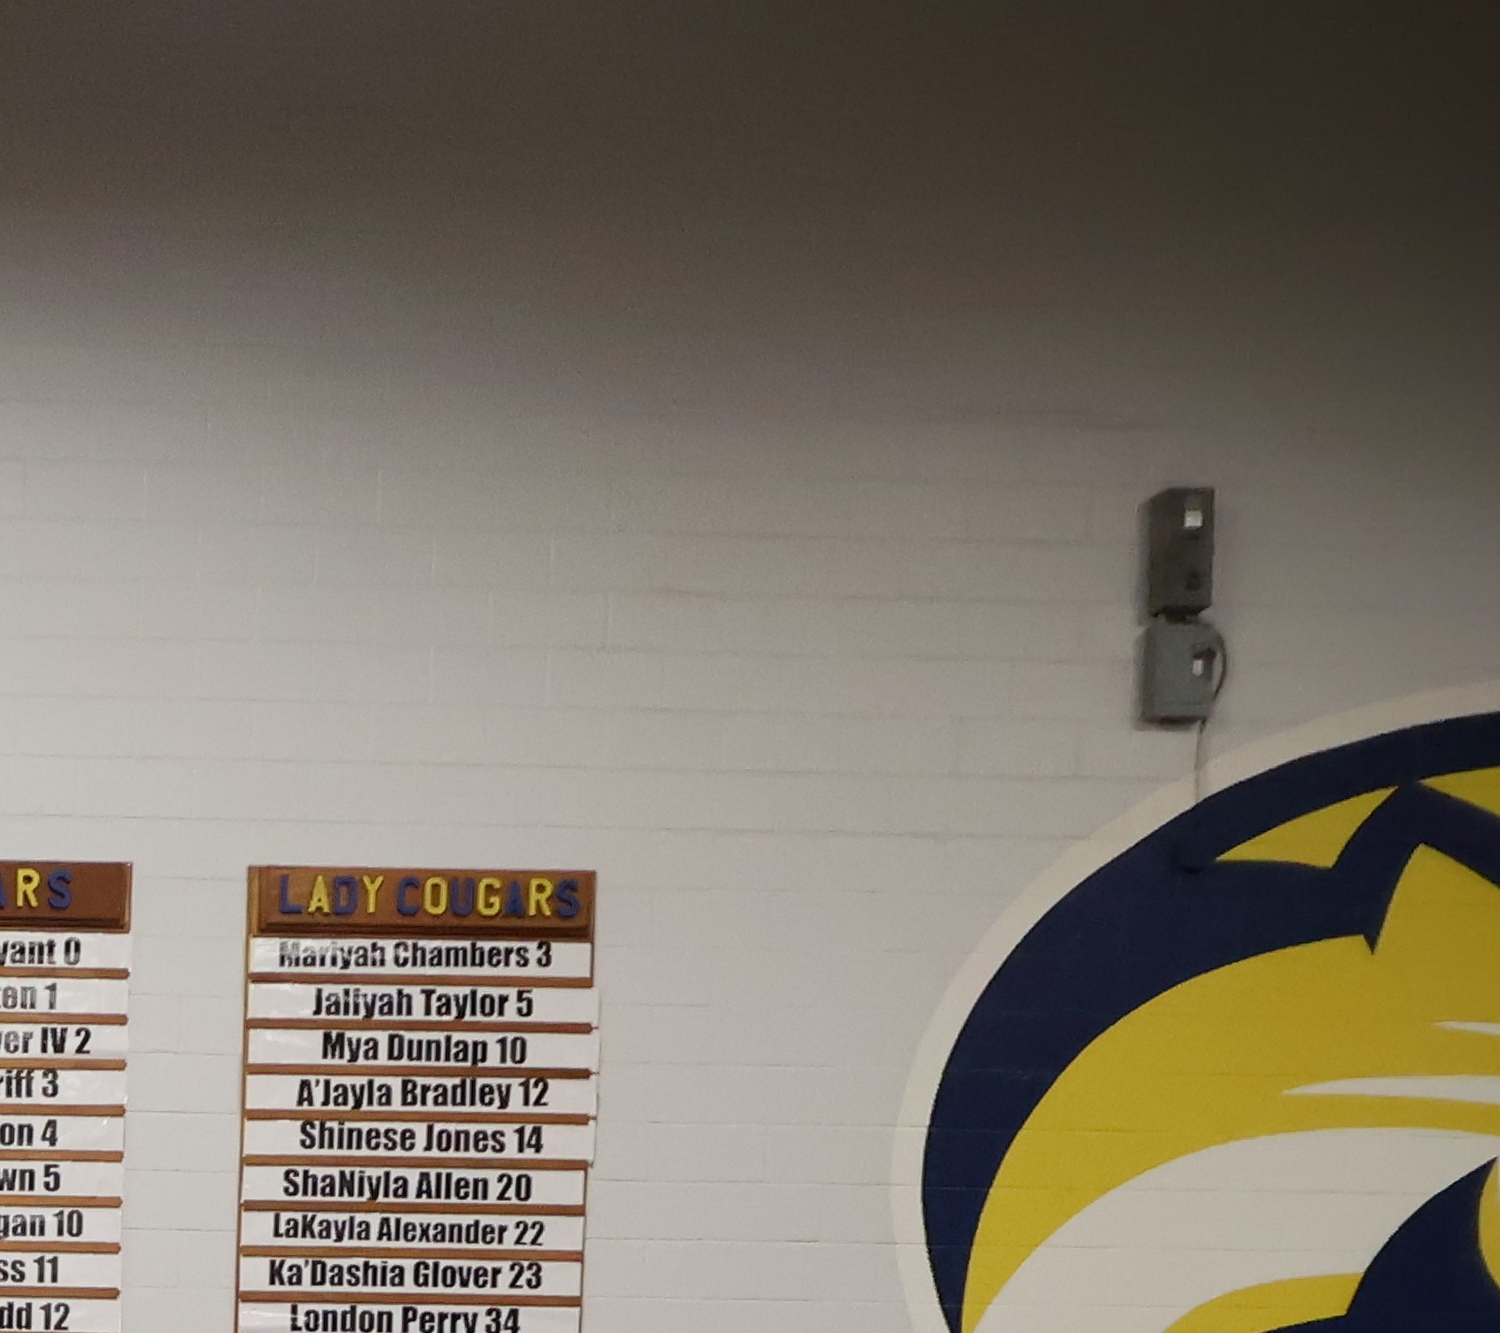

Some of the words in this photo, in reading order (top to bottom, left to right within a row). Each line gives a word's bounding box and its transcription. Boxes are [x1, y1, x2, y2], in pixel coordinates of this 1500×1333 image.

[280, 875, 383, 915] LADY
[396, 876, 579, 918] COUGARS
[64, 937, 81, 965] 0
[394, 941, 529, 968] Chambers
[536, 941, 552, 967] 3
[44, 983, 57, 1010] 1
[420, 989, 509, 1017] Taylor
[517, 989, 533, 1017] 5
[41, 1027, 68, 1054] IV
[75, 1028, 91, 1054] 2
[322, 1032, 378, 1063] Mya
[387, 1034, 488, 1066] Dunlap
[496, 1036, 527, 1064] 10
[41, 1070, 58, 1097] 3
[401, 1081, 512, 1109] Bradley
[519, 1078, 549, 1106] 12
[41, 1119, 58, 1147] 4
[300, 1121, 415, 1151] Shinese
[424, 1124, 506, 1153] Jones
[514, 1125, 543, 1153] 14
[44, 1164, 60, 1192] 5
[283, 1169, 408, 1198] ShaNiyla
[416, 1172, 488, 1200] Allen
[497, 1173, 532, 1201] 20
[53, 1210, 83, 1237] 10
[274, 1214, 370, 1243] LaKayla
[377, 1217, 507, 1245] Alexander
[514, 1221, 544, 1246] 22
[33, 1256, 58, 1283] 11
[413, 1261, 502, 1288] Glover
[509, 1262, 542, 1289] 23
[40, 1303, 70, 1330] 12
[290, 1304, 393, 1333] London
